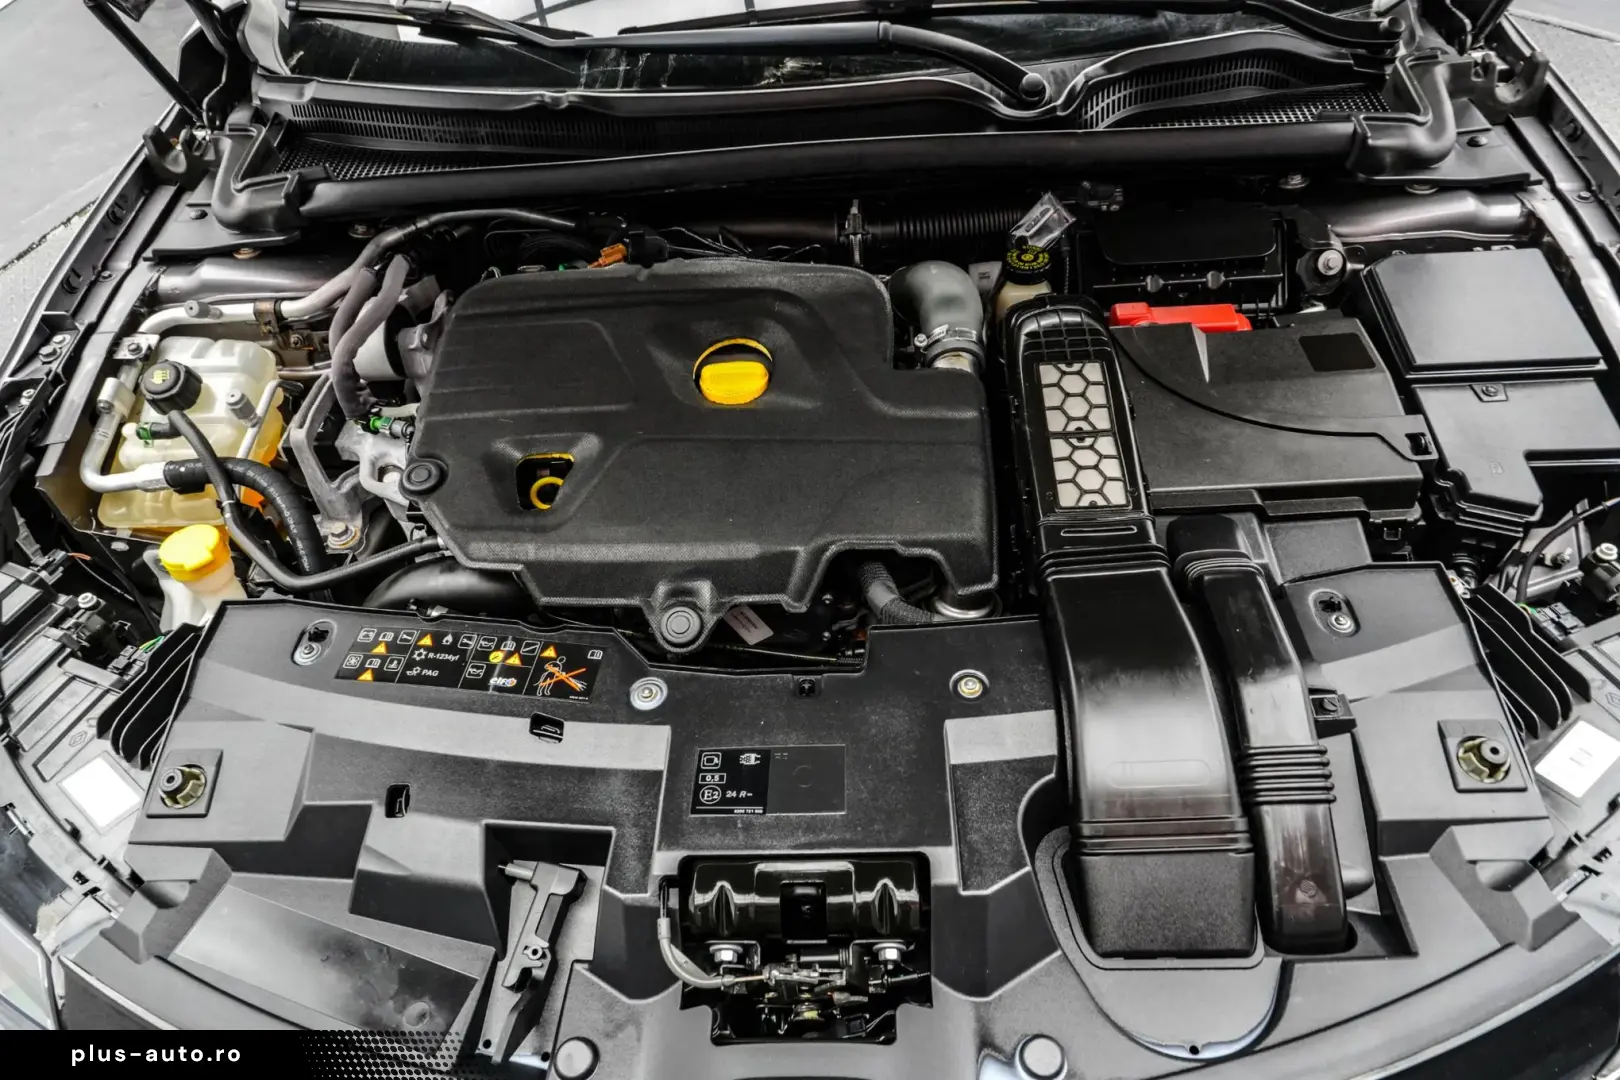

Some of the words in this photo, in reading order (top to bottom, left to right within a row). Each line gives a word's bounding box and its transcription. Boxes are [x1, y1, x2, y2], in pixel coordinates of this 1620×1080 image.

[428, 652, 460, 662] R-1234yf
[421, 669, 439, 677] PAG
[703, 789, 719, 801] E2
[726, 790, 737, 798] 24
